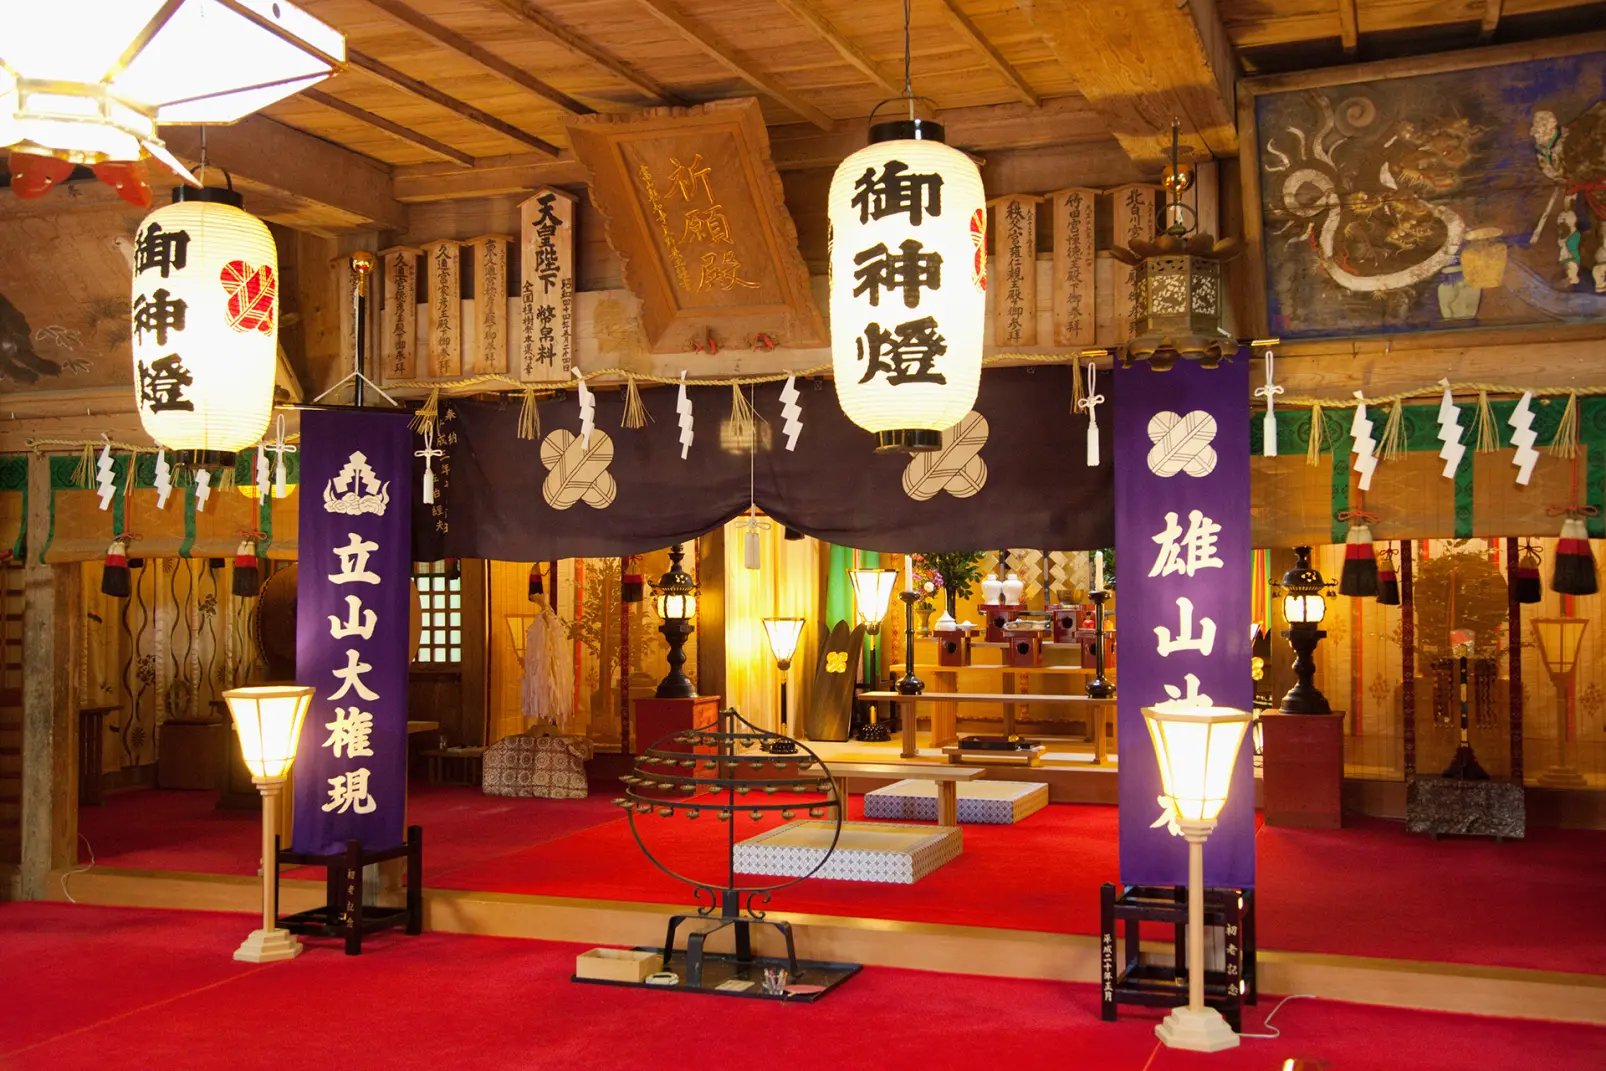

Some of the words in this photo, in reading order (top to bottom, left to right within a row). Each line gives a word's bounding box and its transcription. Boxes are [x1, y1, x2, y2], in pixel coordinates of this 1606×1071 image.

[532, 193, 563, 294] 天皇陛下
[663, 153, 760, 294] 祈願殿
[851, 160, 947, 386] 御神燈
[134, 222, 194, 415] 御神燈
[321, 532, 381, 815] 立山大権現
[1226, 923, 1239, 997] 初老記念
